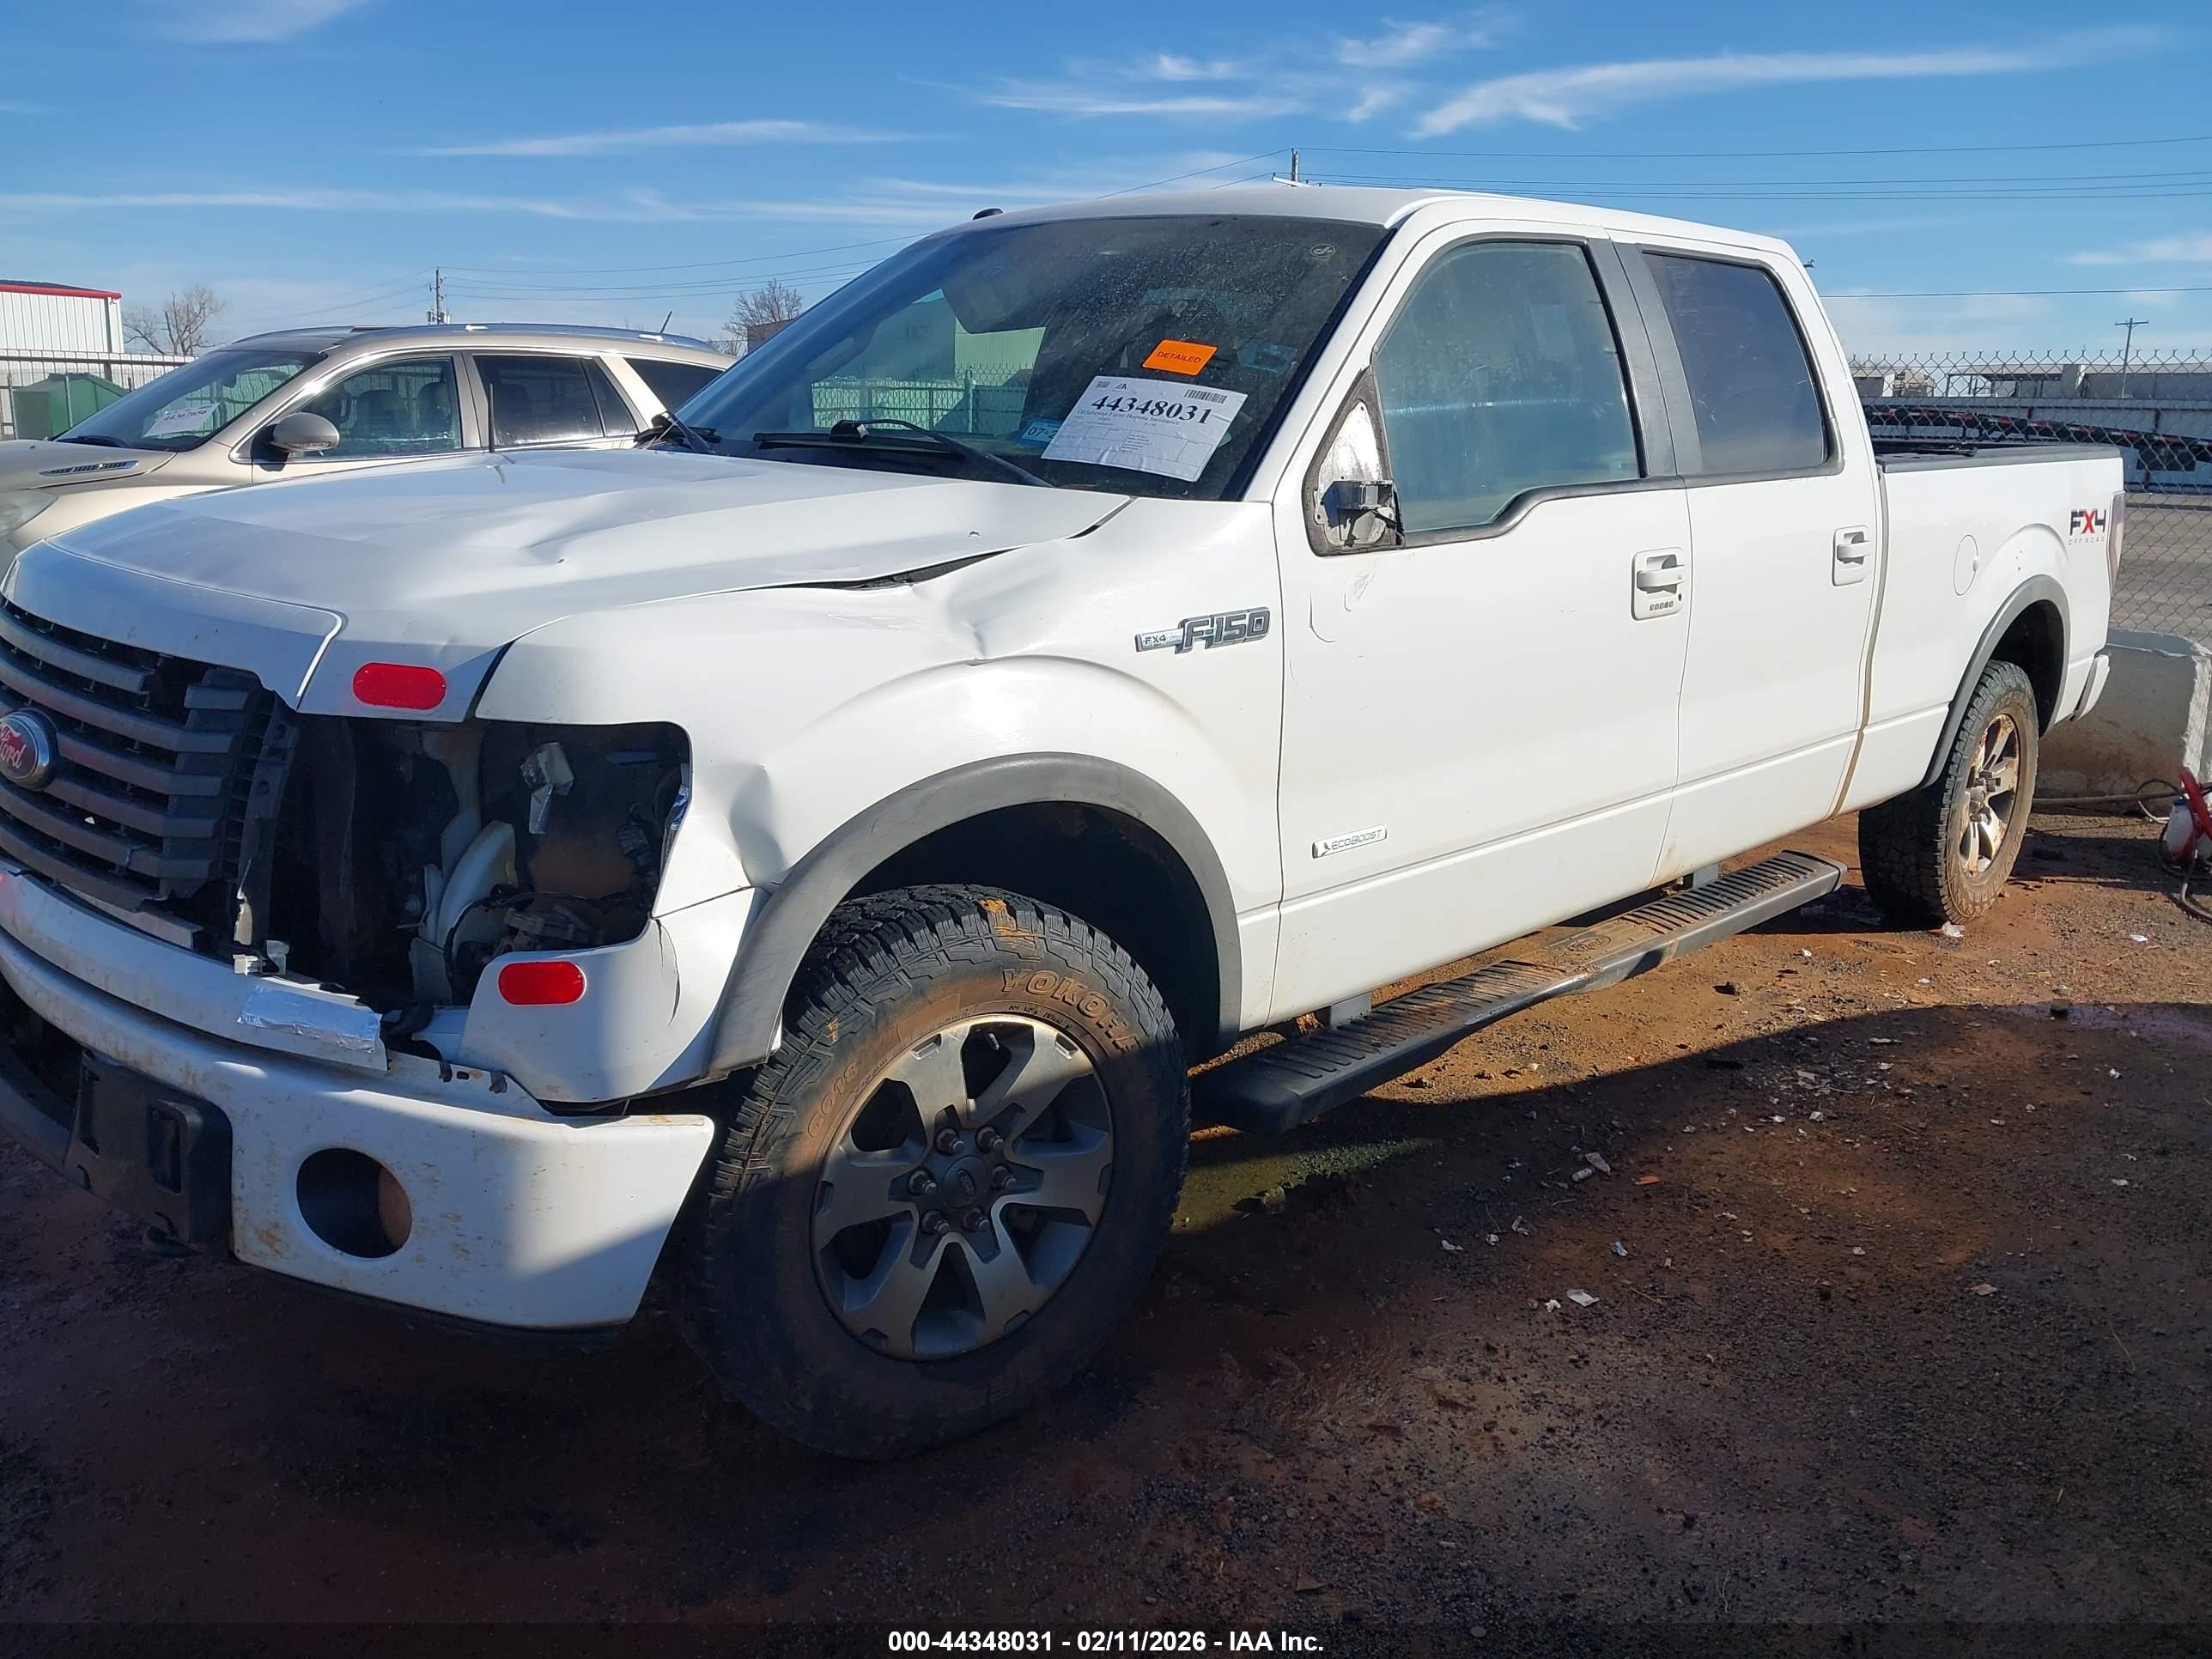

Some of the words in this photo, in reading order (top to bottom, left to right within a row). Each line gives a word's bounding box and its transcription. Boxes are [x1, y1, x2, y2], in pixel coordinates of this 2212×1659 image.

[1156, 351, 1202, 363] DETAILED
[1091, 395, 1212, 425] 44348031
[2069, 508, 2106, 536] FX4
[1144, 634, 1168, 646] FX4
[1176, 607, 1271, 653] F-150
